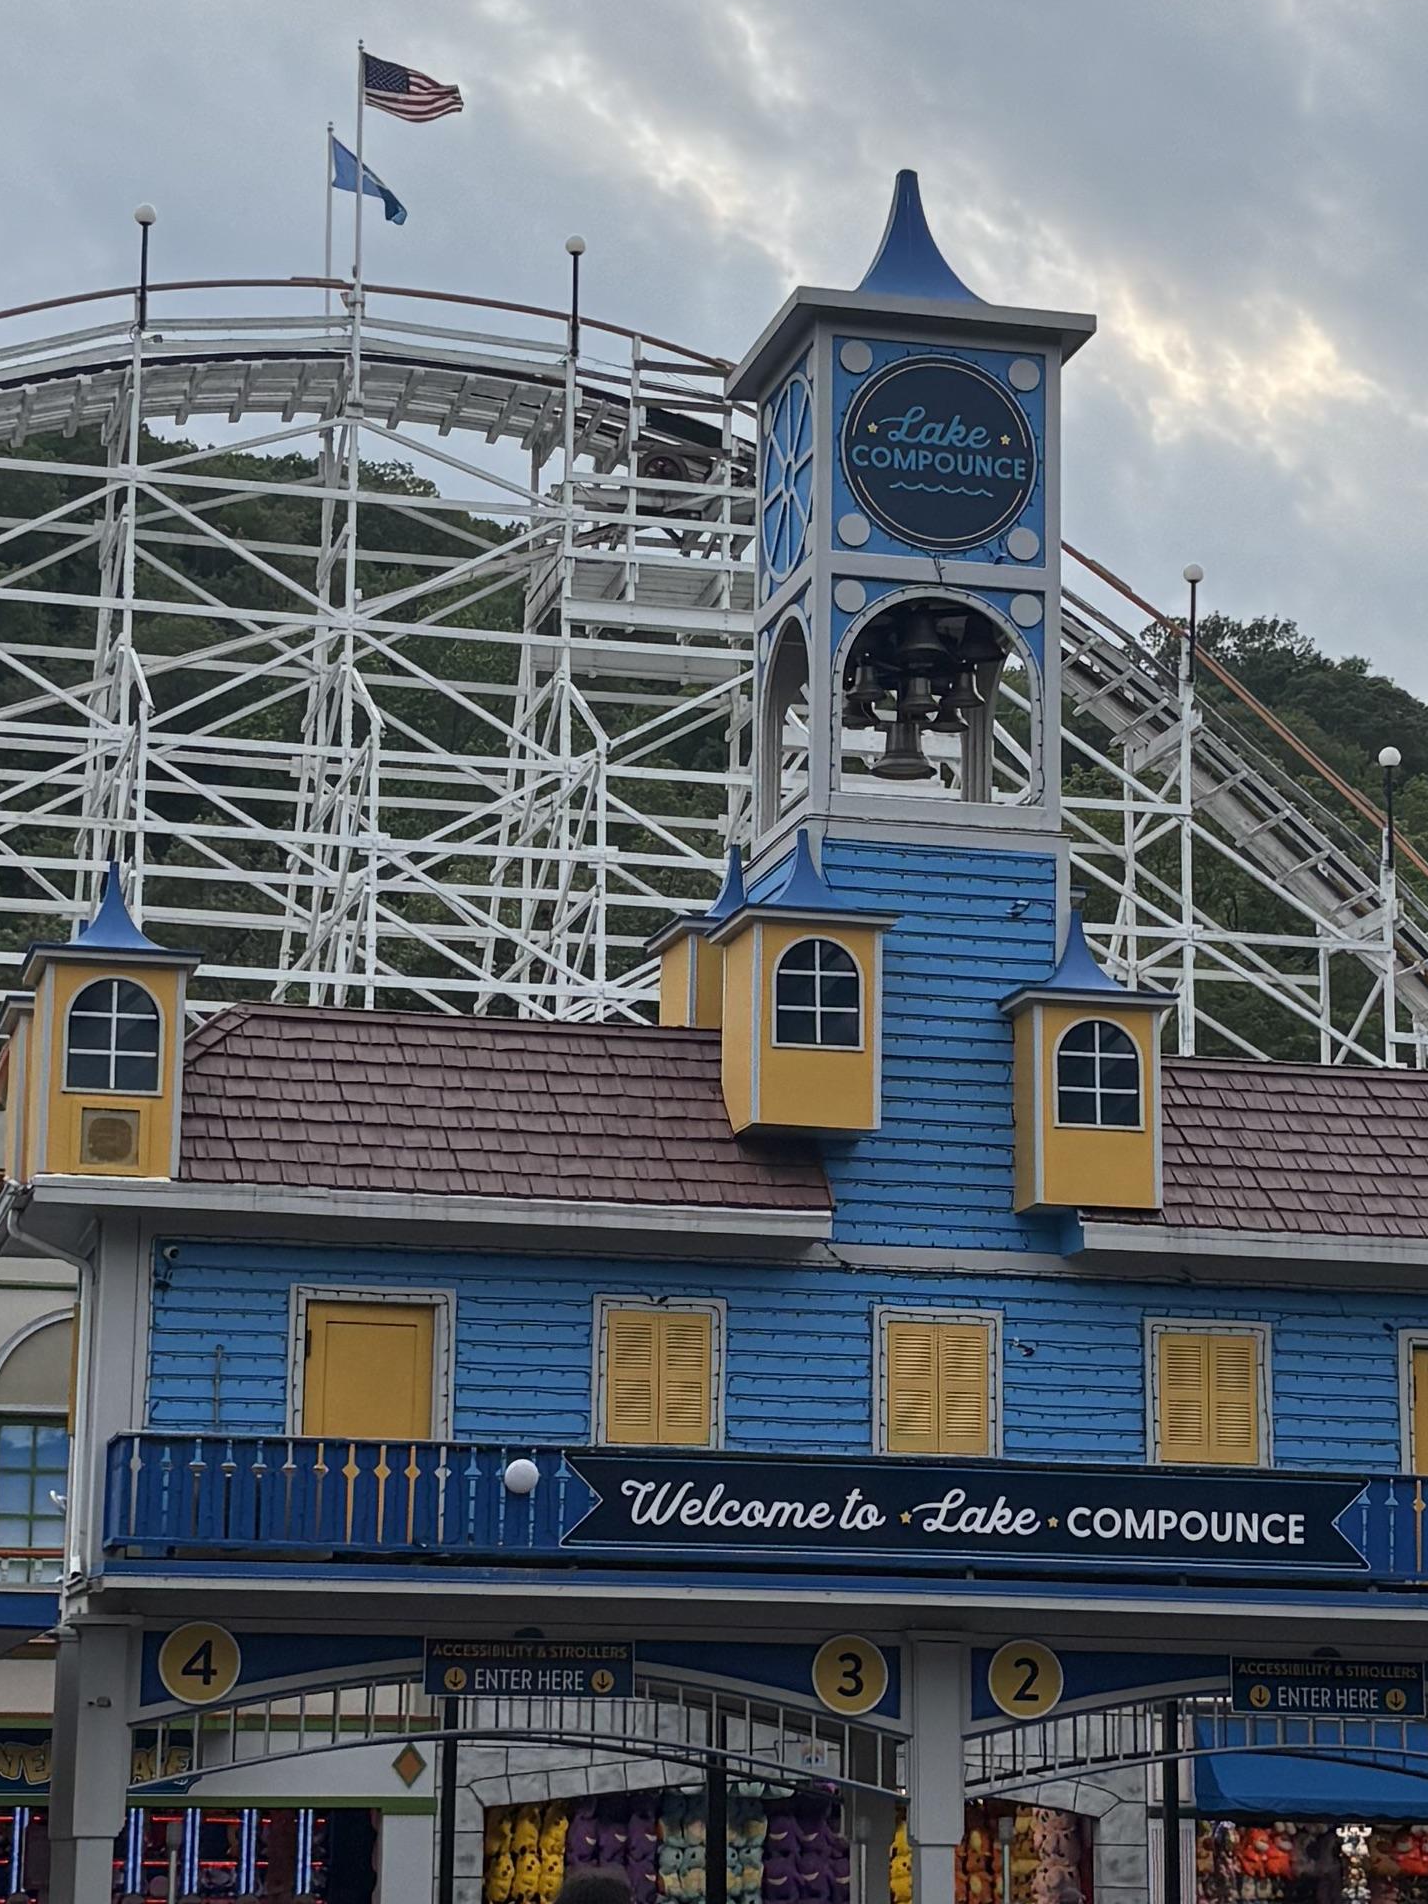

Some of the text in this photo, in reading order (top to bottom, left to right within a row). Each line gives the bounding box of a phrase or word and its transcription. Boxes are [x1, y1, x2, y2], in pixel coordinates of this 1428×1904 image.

[880, 406, 991, 450] Lake
[851, 444, 1027, 482] COMPOUNCE
[620, 1479, 1306, 1546] Welcome to Lake COMPOUNCE
[180, 1639, 218, 1686] 4
[432, 1644, 628, 1659] ACCESSIBILITY & STROLLERS
[1238, 1662, 1419, 1679] ACCESSIBILITY & STROLLERS
[474, 1668, 585, 1691] ENTER HERE
[836, 1651, 865, 1699] 3
[1012, 1656, 1041, 1703] 2
[1277, 1686, 1379, 1710] ENTER HERE
